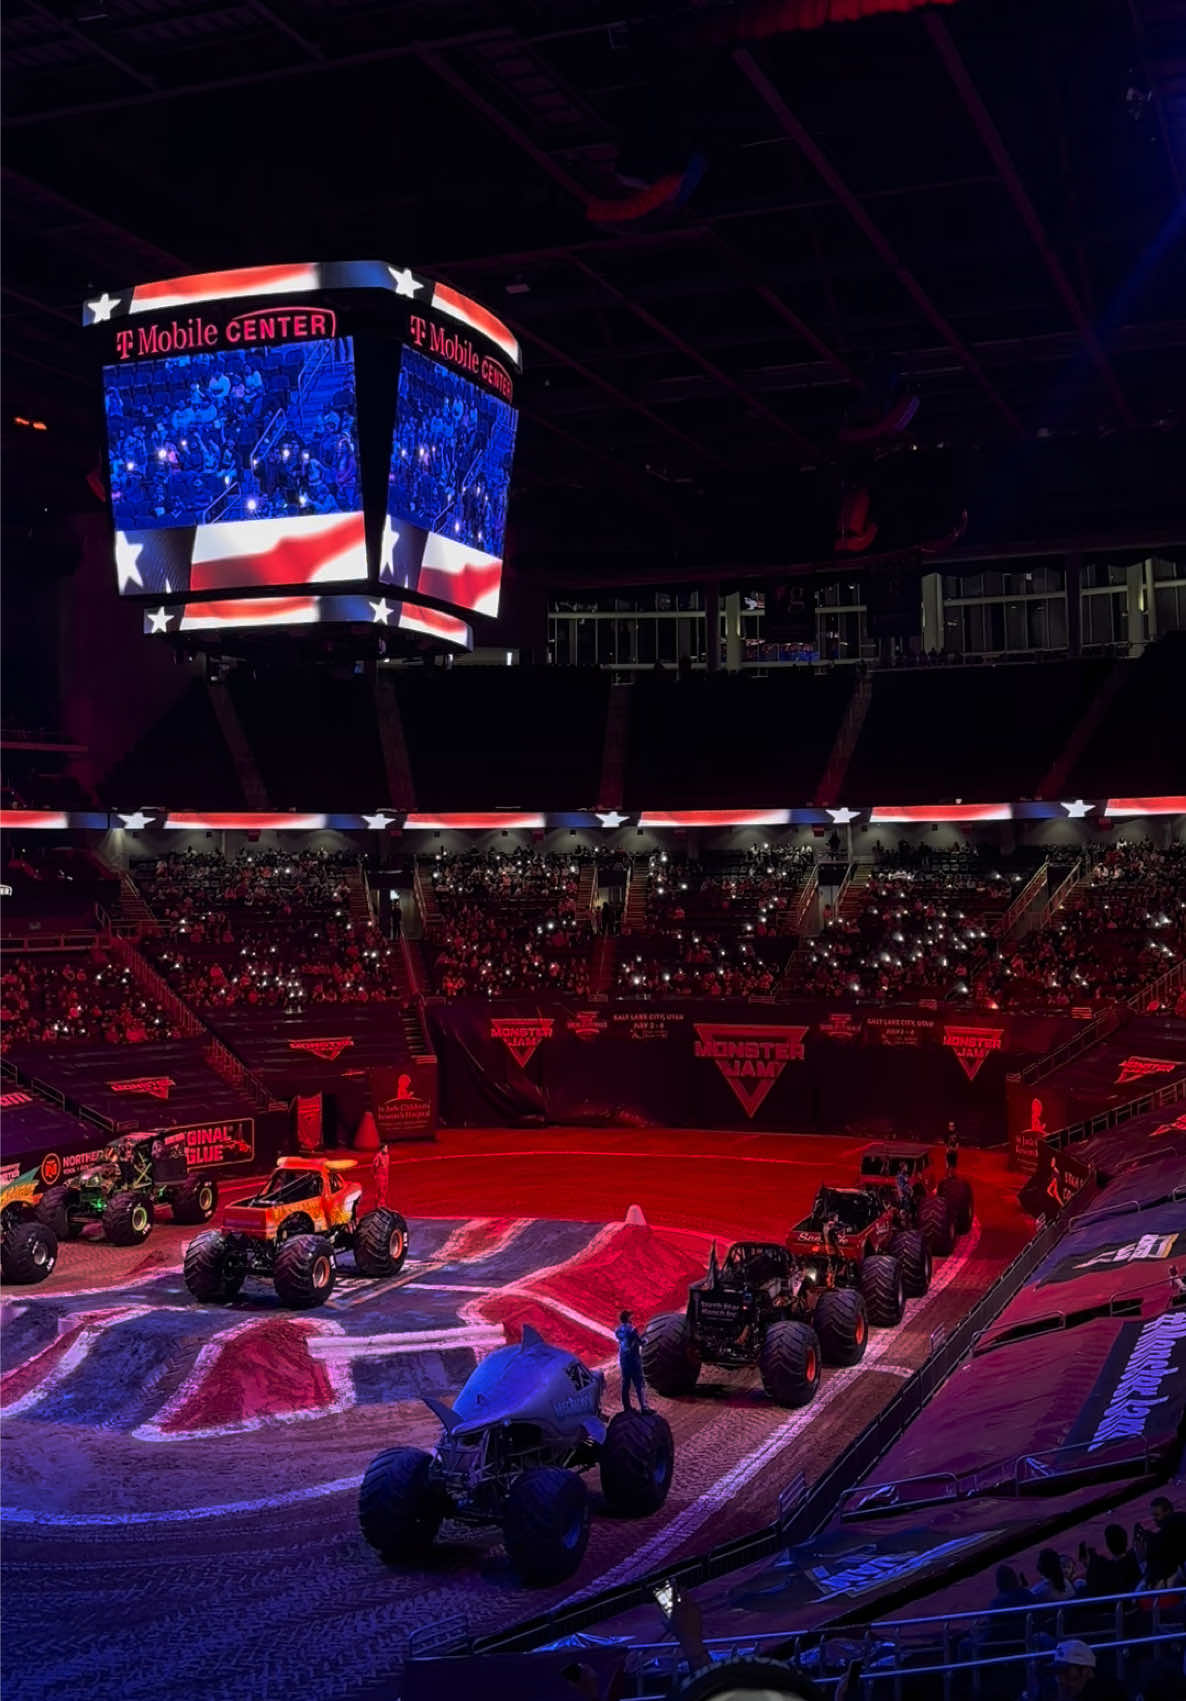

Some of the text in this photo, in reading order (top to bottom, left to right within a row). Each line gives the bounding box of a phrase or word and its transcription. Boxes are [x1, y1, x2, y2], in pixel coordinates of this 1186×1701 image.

[225, 313, 326, 343] CENTER
[481, 355, 513, 398] CENTER
[490, 1028, 553, 1039] MONSTER
[943, 1035, 1002, 1049] MONSTER
[694, 1040, 806, 1061] MONSTER
[955, 1047, 987, 1058] JAM
[724, 1060, 779, 1078] JAM
[186, 1127, 232, 1146] GINAL
[63, 1150, 104, 1167] NORTHE
